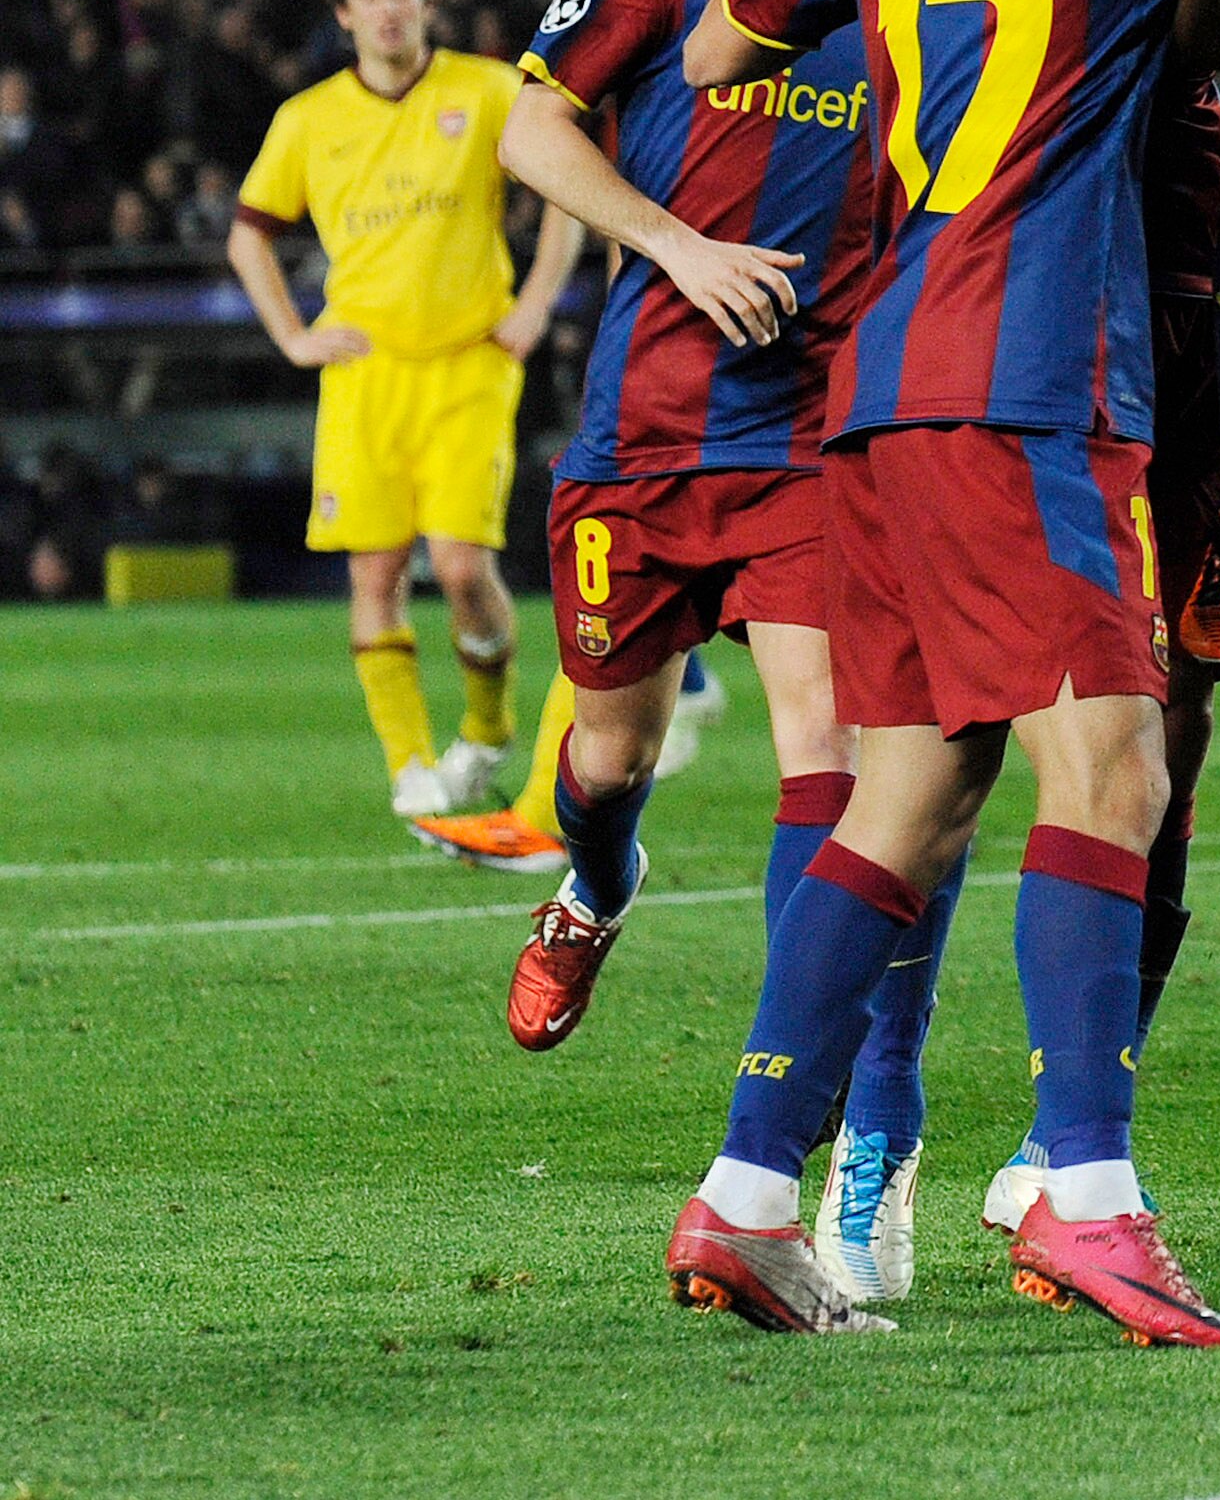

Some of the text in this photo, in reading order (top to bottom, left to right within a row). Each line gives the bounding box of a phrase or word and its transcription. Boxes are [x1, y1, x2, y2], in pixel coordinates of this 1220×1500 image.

[707, 67, 868, 132] unicef
[574, 517, 612, 605] 8
[1130, 496, 1155, 600] 1
[736, 1052, 794, 1079] FCB
